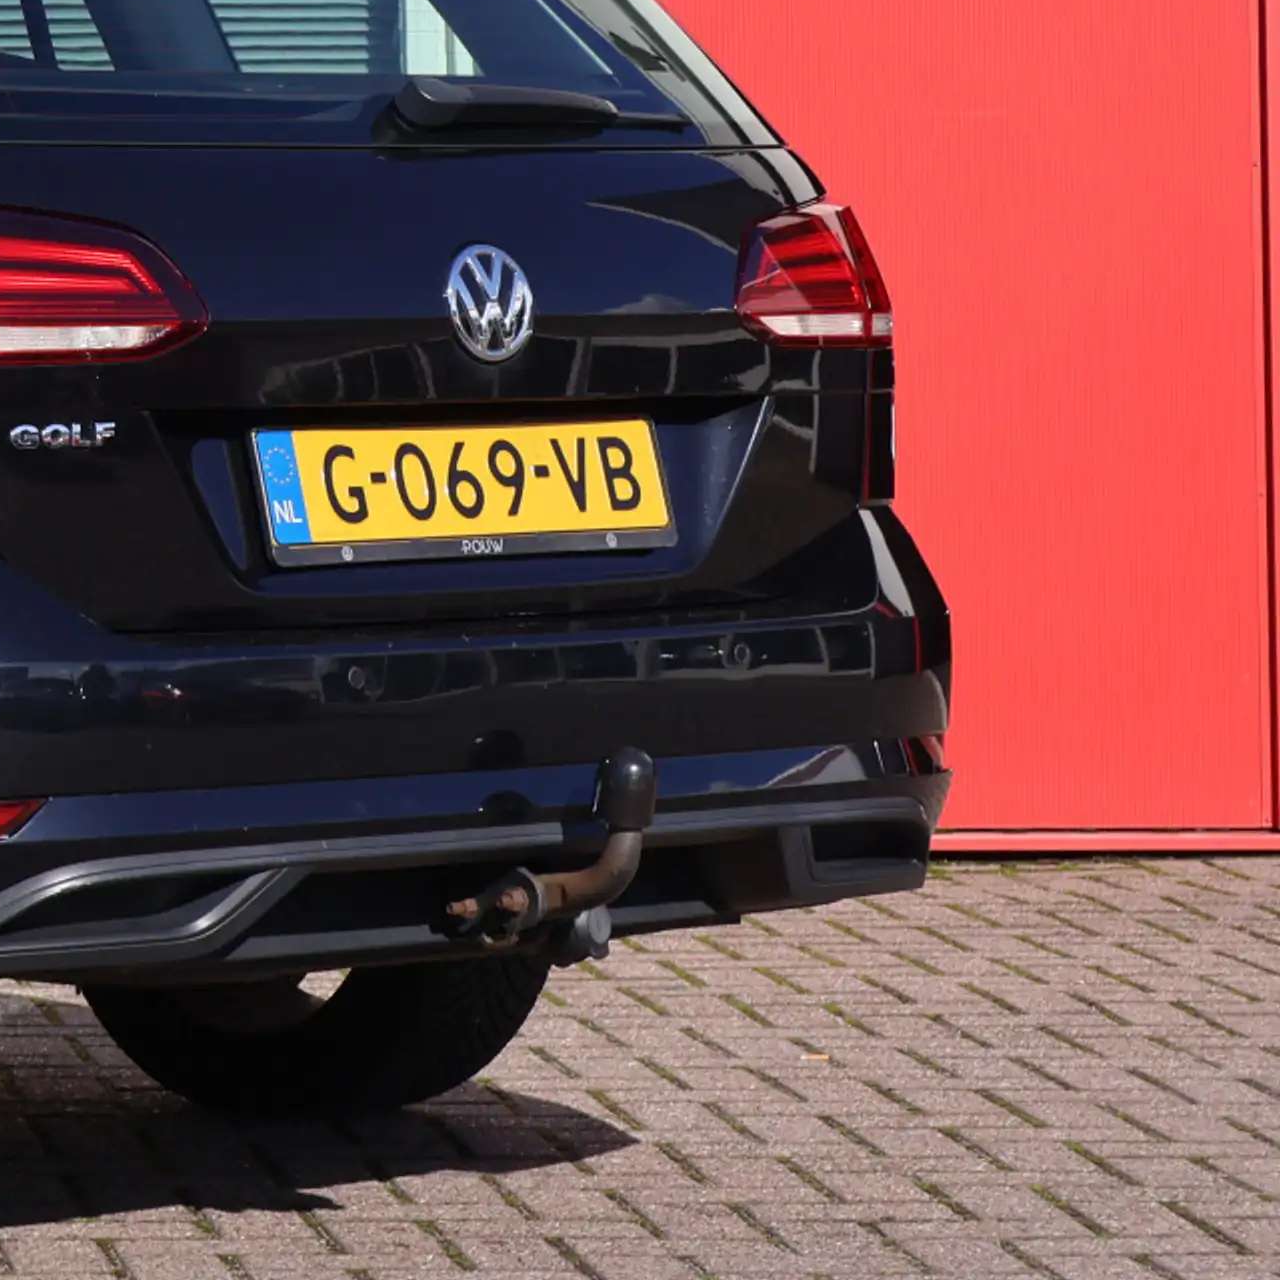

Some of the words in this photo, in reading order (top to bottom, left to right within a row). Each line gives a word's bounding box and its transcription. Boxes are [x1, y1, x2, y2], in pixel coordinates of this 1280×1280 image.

[9, 421, 116, 450] GOLF
[322, 436, 643, 524] G-069-VB
[273, 499, 303, 525] NL
